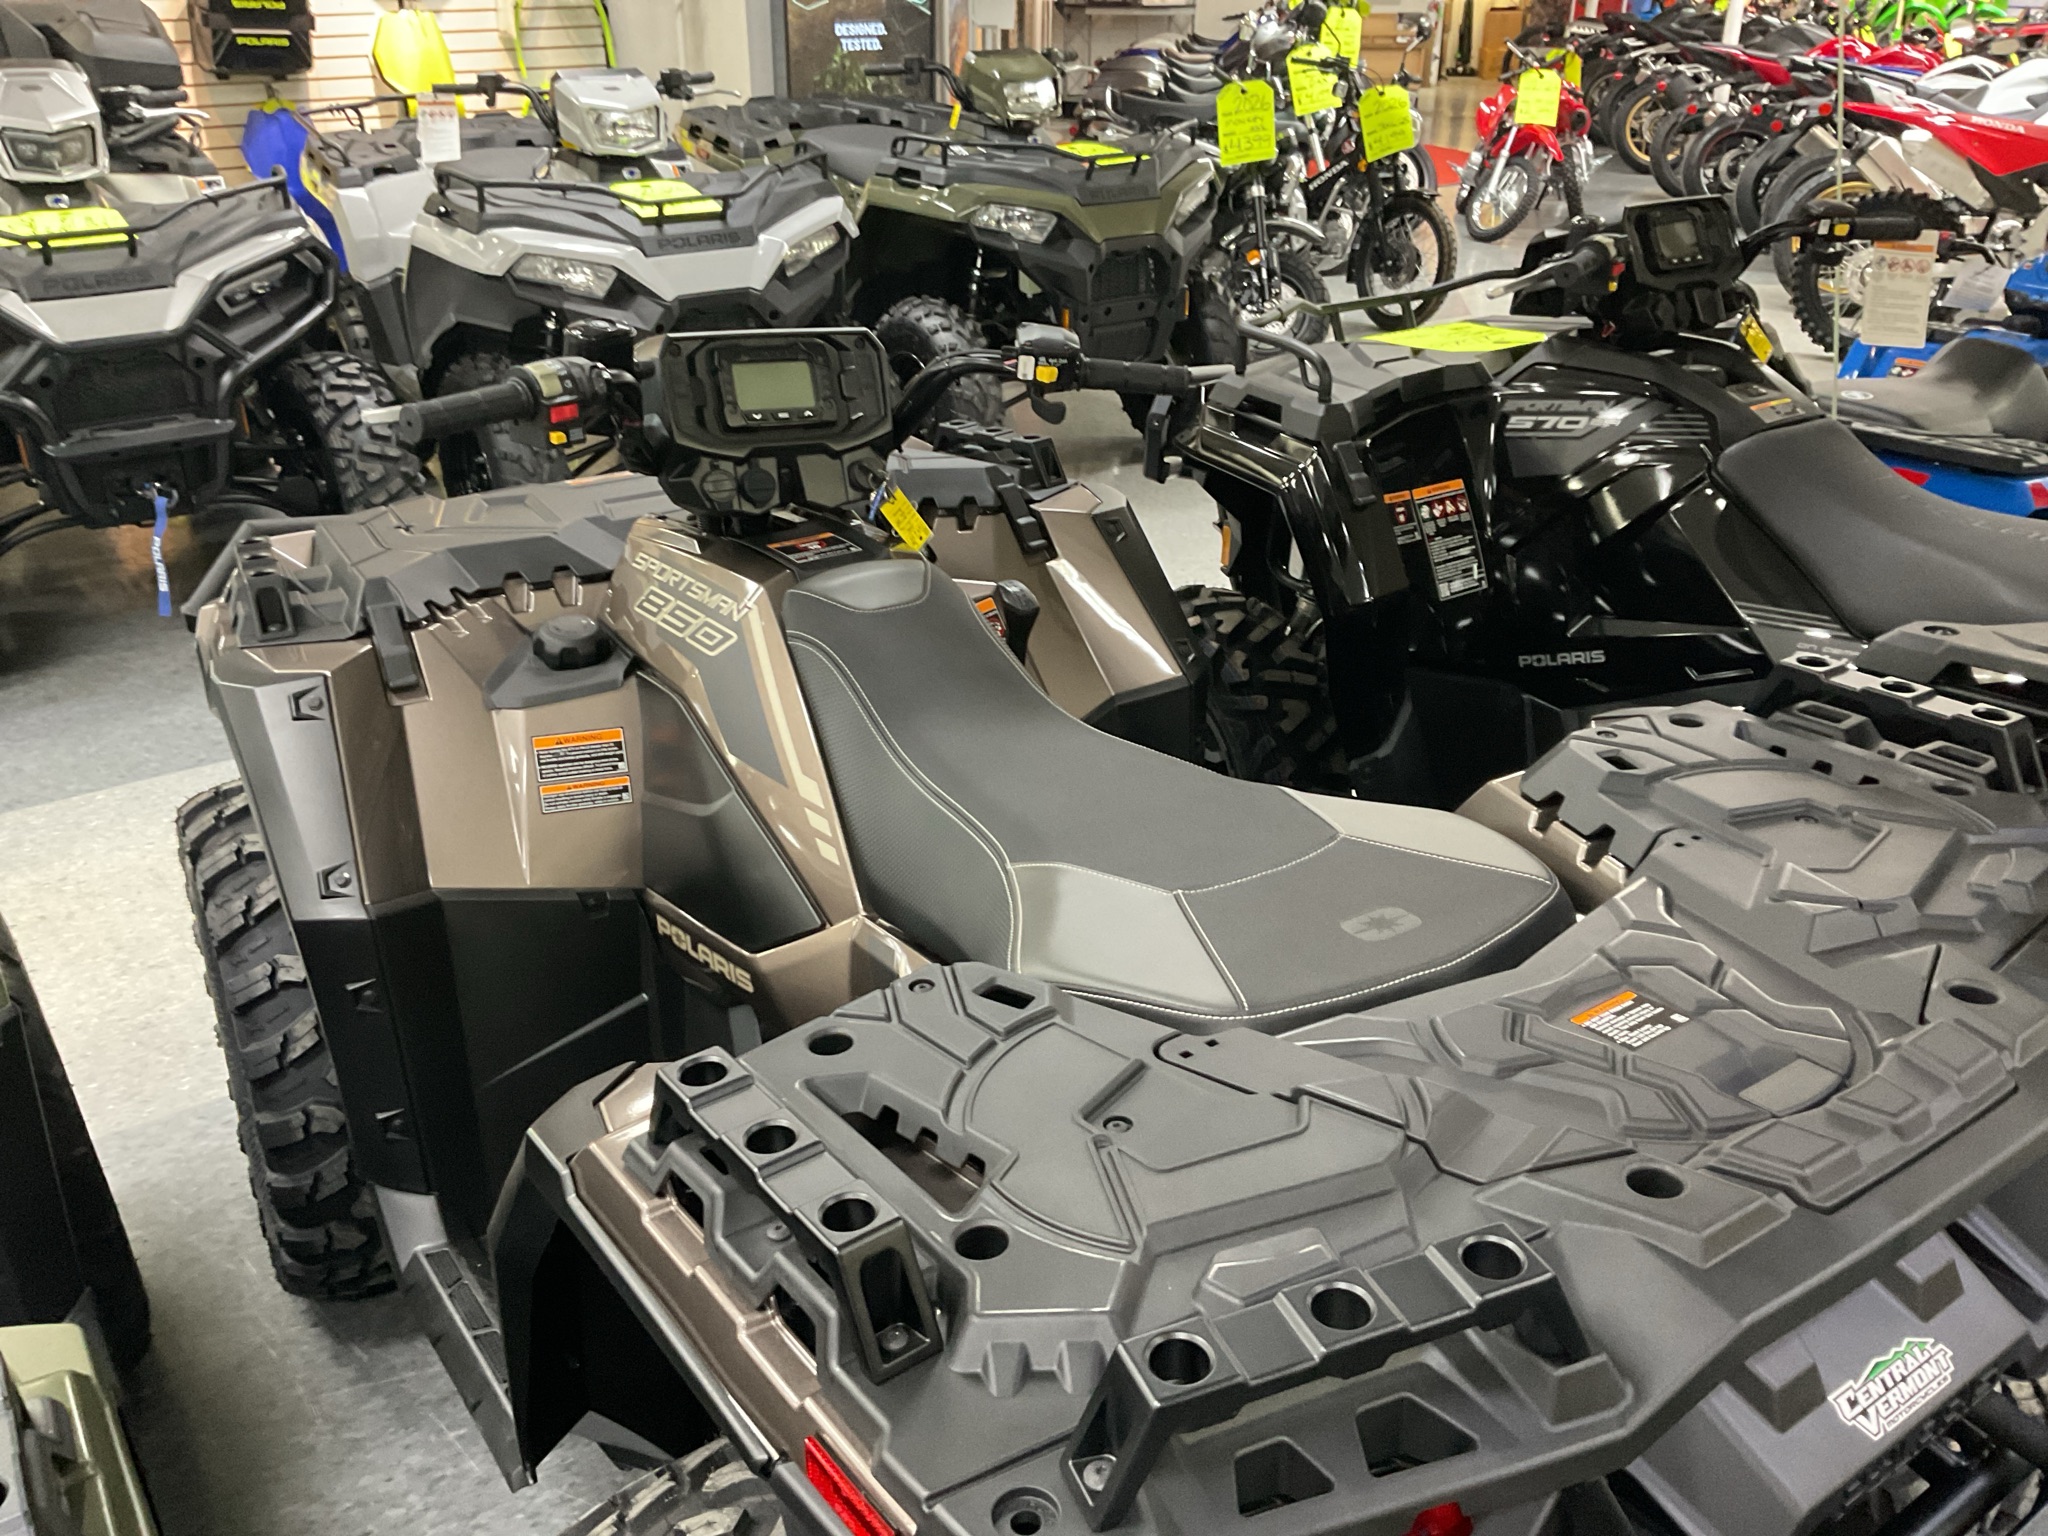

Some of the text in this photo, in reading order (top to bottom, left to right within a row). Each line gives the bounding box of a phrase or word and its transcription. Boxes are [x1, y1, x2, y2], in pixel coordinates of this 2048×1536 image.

[834, 22, 888, 36] DESIGNED.
[840, 37, 883, 51] TESTED.
[1971, 115, 2025, 134] HONDA
[657, 231, 741, 249] POLARIS
[1506, 415, 1590, 430] 570
[151, 535, 169, 592] POLARIS
[632, 552, 752, 622] SPORTSMAN
[634, 586, 738, 656] 850
[1518, 650, 1607, 667] POLARIS
[656, 914, 754, 993] POLARIS
[1836, 1346, 1932, 1420] CENTRAL
[1856, 1350, 1950, 1436] VERMONT
